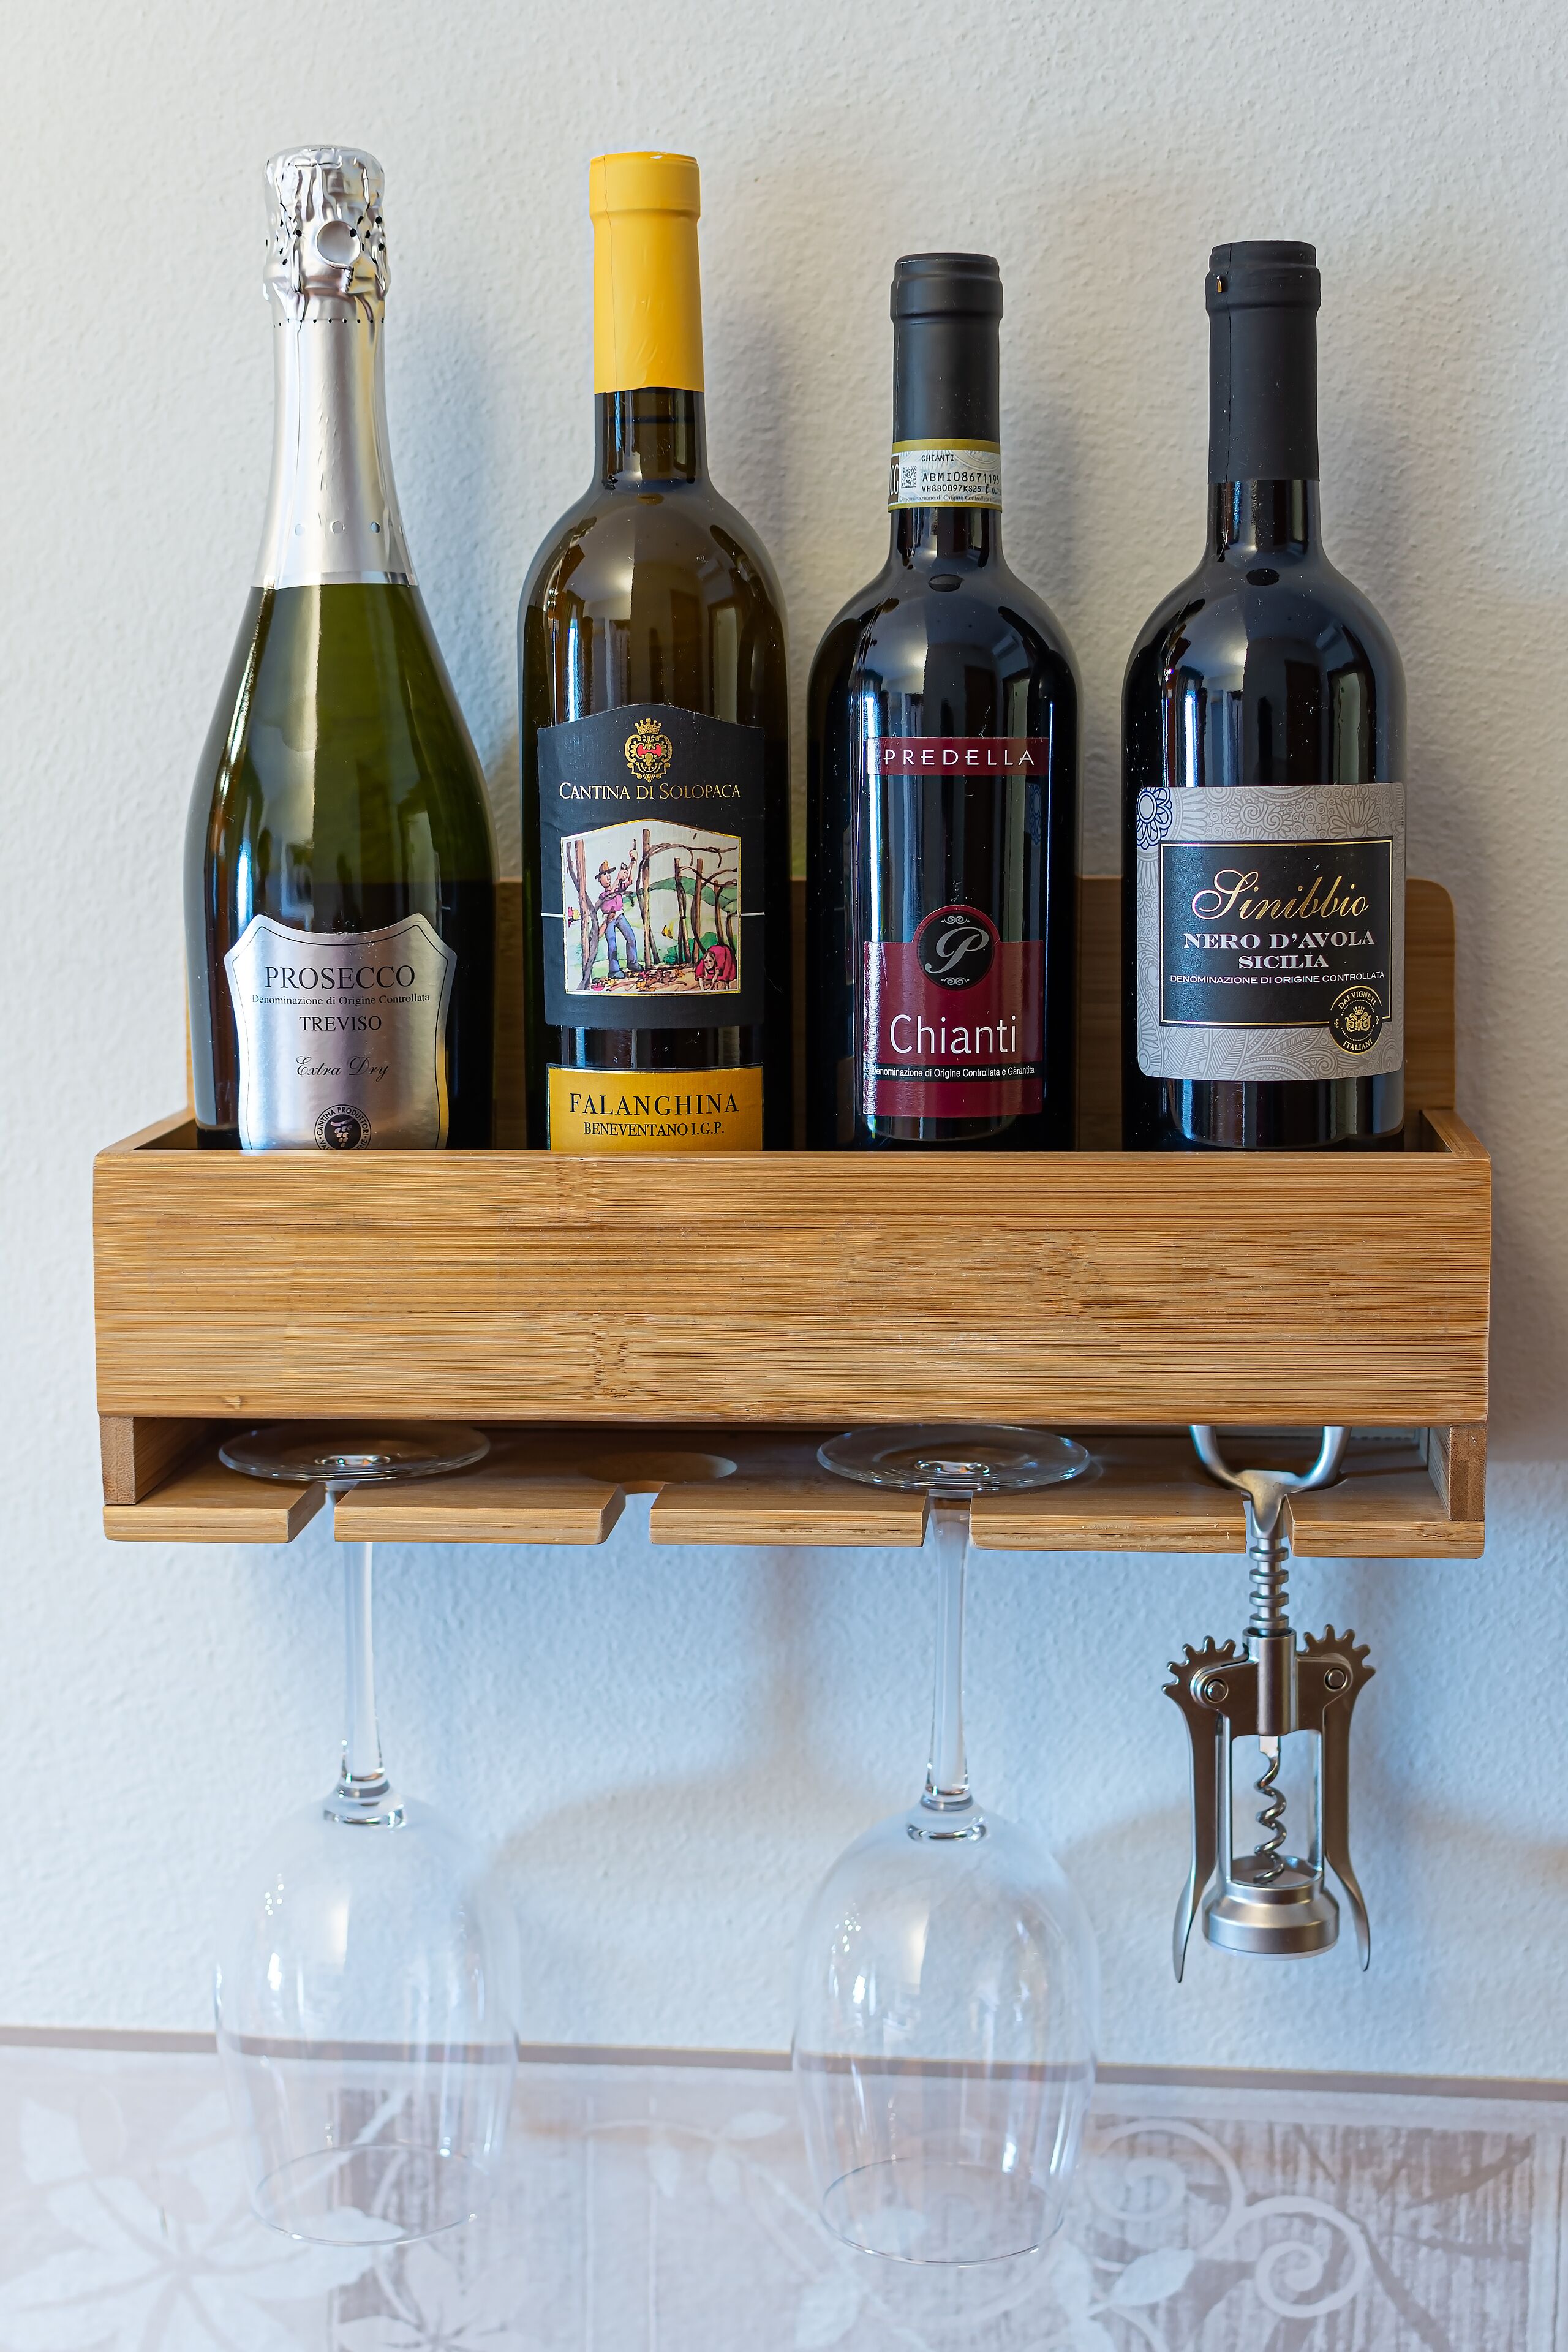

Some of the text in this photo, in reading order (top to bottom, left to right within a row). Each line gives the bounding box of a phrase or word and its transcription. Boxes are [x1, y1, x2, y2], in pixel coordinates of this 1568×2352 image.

[883, 749, 1035, 766] PREDELLA
[559, 782, 741, 801] CANTINA DI SOLOPACA
[1191, 869, 1370, 920] Sinibbio
[1183, 929, 1375, 949] NERO D'AVOLA
[1238, 954, 1329, 969] SICILIA
[264, 965, 416, 990] PROSECCO
[1170, 974, 1259, 984] DENOMINAZIONE
[1275, 975, 1321, 984] ORIGINE
[1322, 971, 1385, 982] CONTROLLATA
[252, 993, 430, 1007] Denominazione di Origine Controllata
[1338, 990, 1377, 1009] DAI VIGNETI
[299, 1015, 382, 1031] TREVISO
[890, 1014, 1016, 1054] Chianti
[1343, 1038, 1373, 1051] ITALIANI
[296, 1055, 390, 1082] Extra Dry
[872, 1067, 923, 1077] Denominazione
[925, 1068, 932, 1077] di
[933, 1068, 961, 1079] Origine
[962, 1068, 1001, 1077] Controllata
[569, 1093, 739, 1116] FALANGHINA
[317, 1107, 369, 1136] CANTINA PRODUTTORI
[584, 1121, 725, 1137] BENEVENTANO I.G.P.
